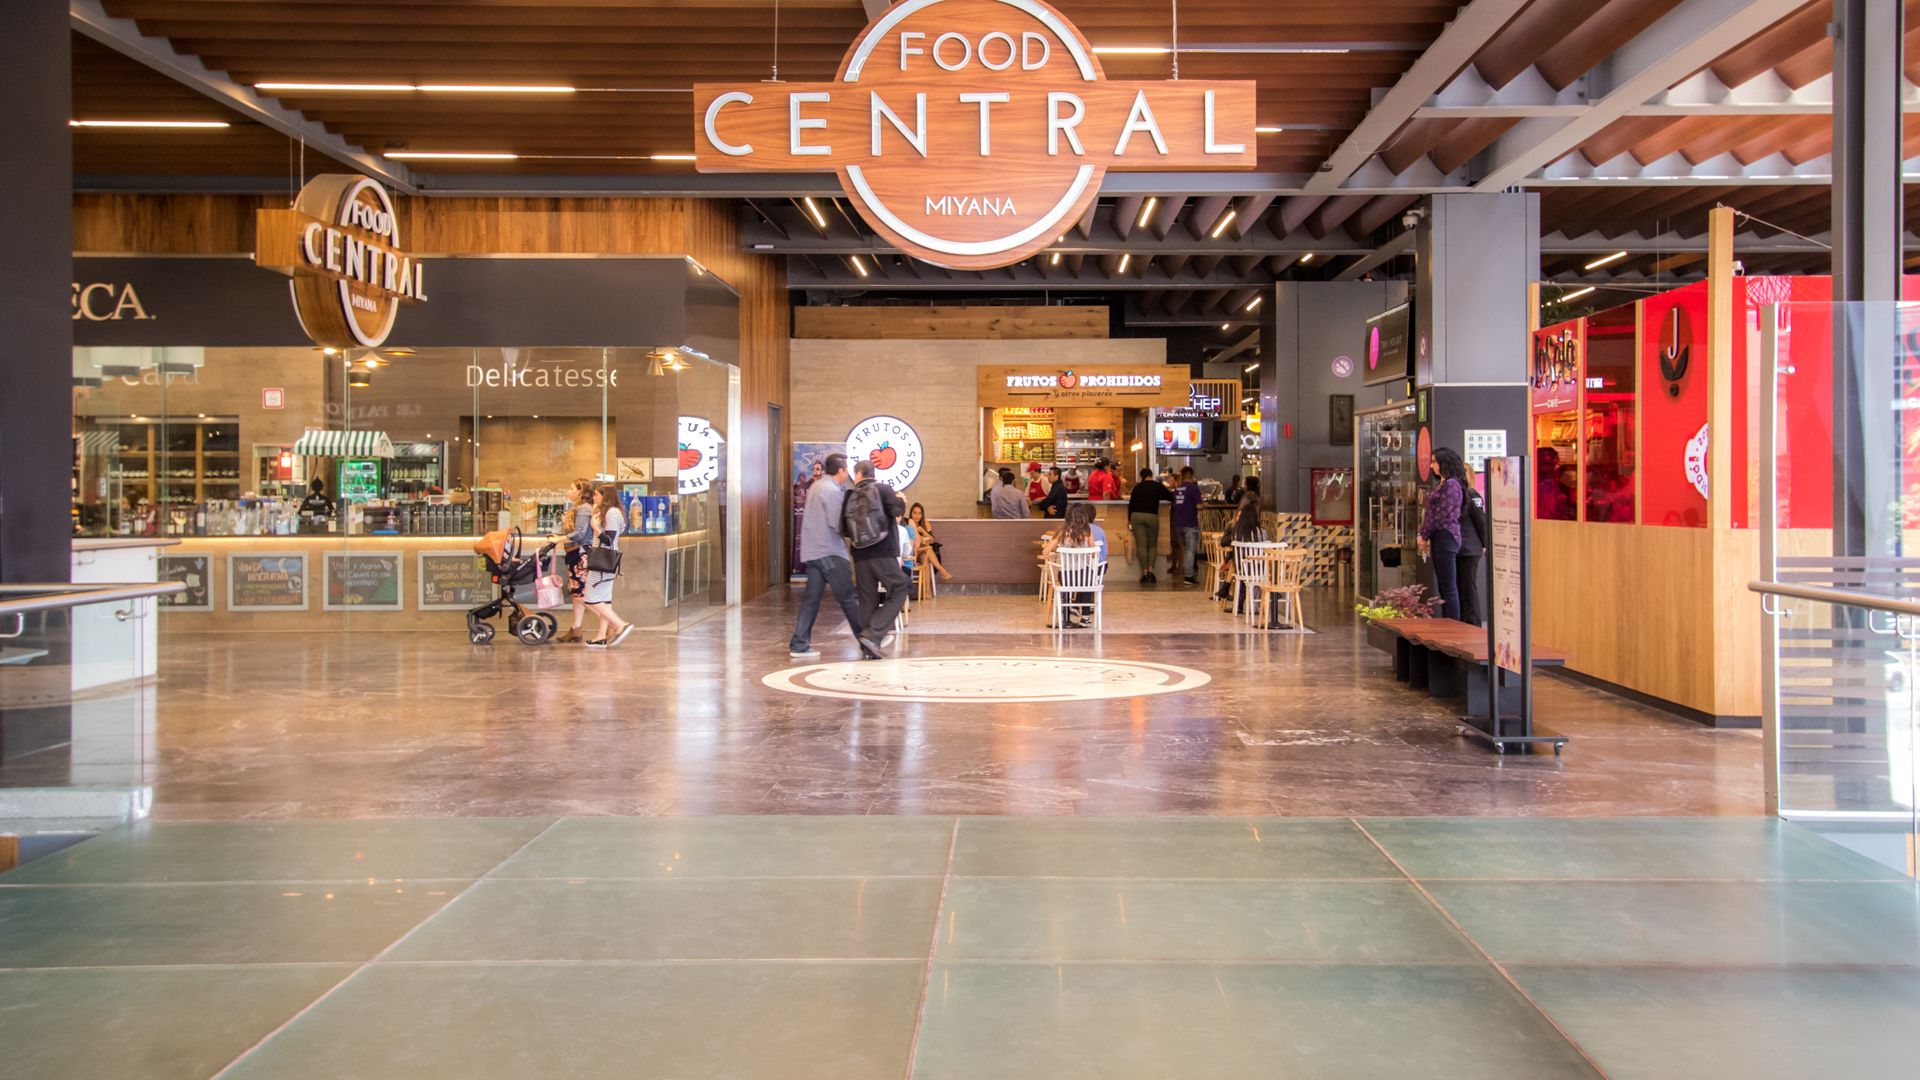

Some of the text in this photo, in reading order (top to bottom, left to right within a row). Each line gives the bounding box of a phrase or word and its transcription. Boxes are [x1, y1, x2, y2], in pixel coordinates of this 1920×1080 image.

[900, 31, 1050, 72] FOOD
[703, 88, 1246, 158] CENTRAL
[351, 200, 392, 237] FOOD
[926, 195, 1017, 217] MIYANA
[303, 222, 428, 302] CENTRAL
[351, 293, 377, 313] MIYANA
[1006, 375, 1162, 388] FRUTOS PROHIBIDOS
[855, 422, 910, 444] FRUTOS
[849, 450, 917, 488] PBIDOS
